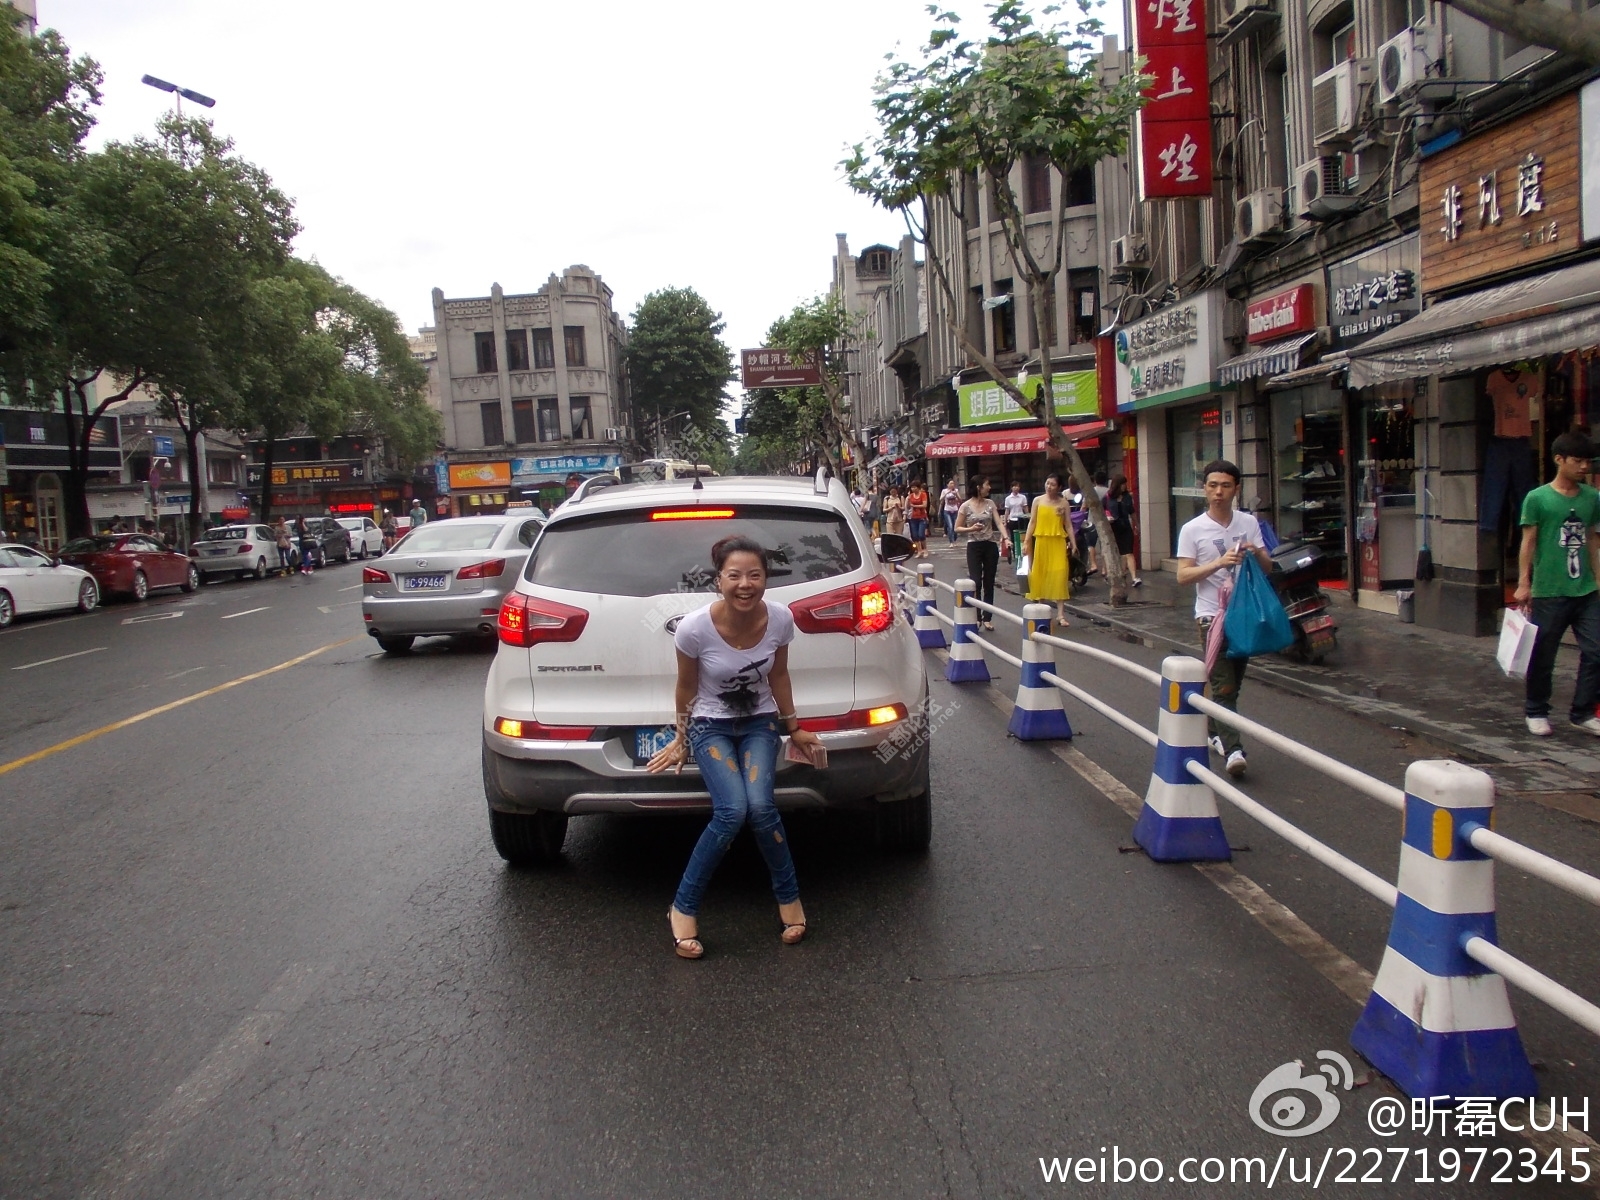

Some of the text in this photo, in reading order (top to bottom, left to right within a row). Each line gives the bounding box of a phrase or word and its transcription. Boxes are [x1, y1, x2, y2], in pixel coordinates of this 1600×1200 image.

[1148, 0, 1199, 182] 煌上煌
[1440, 152, 1543, 242] 非凡度
[1335, 270, 1399, 315] 银河之恋
[1340, 320, 1369, 338] Galaxy
[1130, 356, 1185, 389] 24 自助银行
